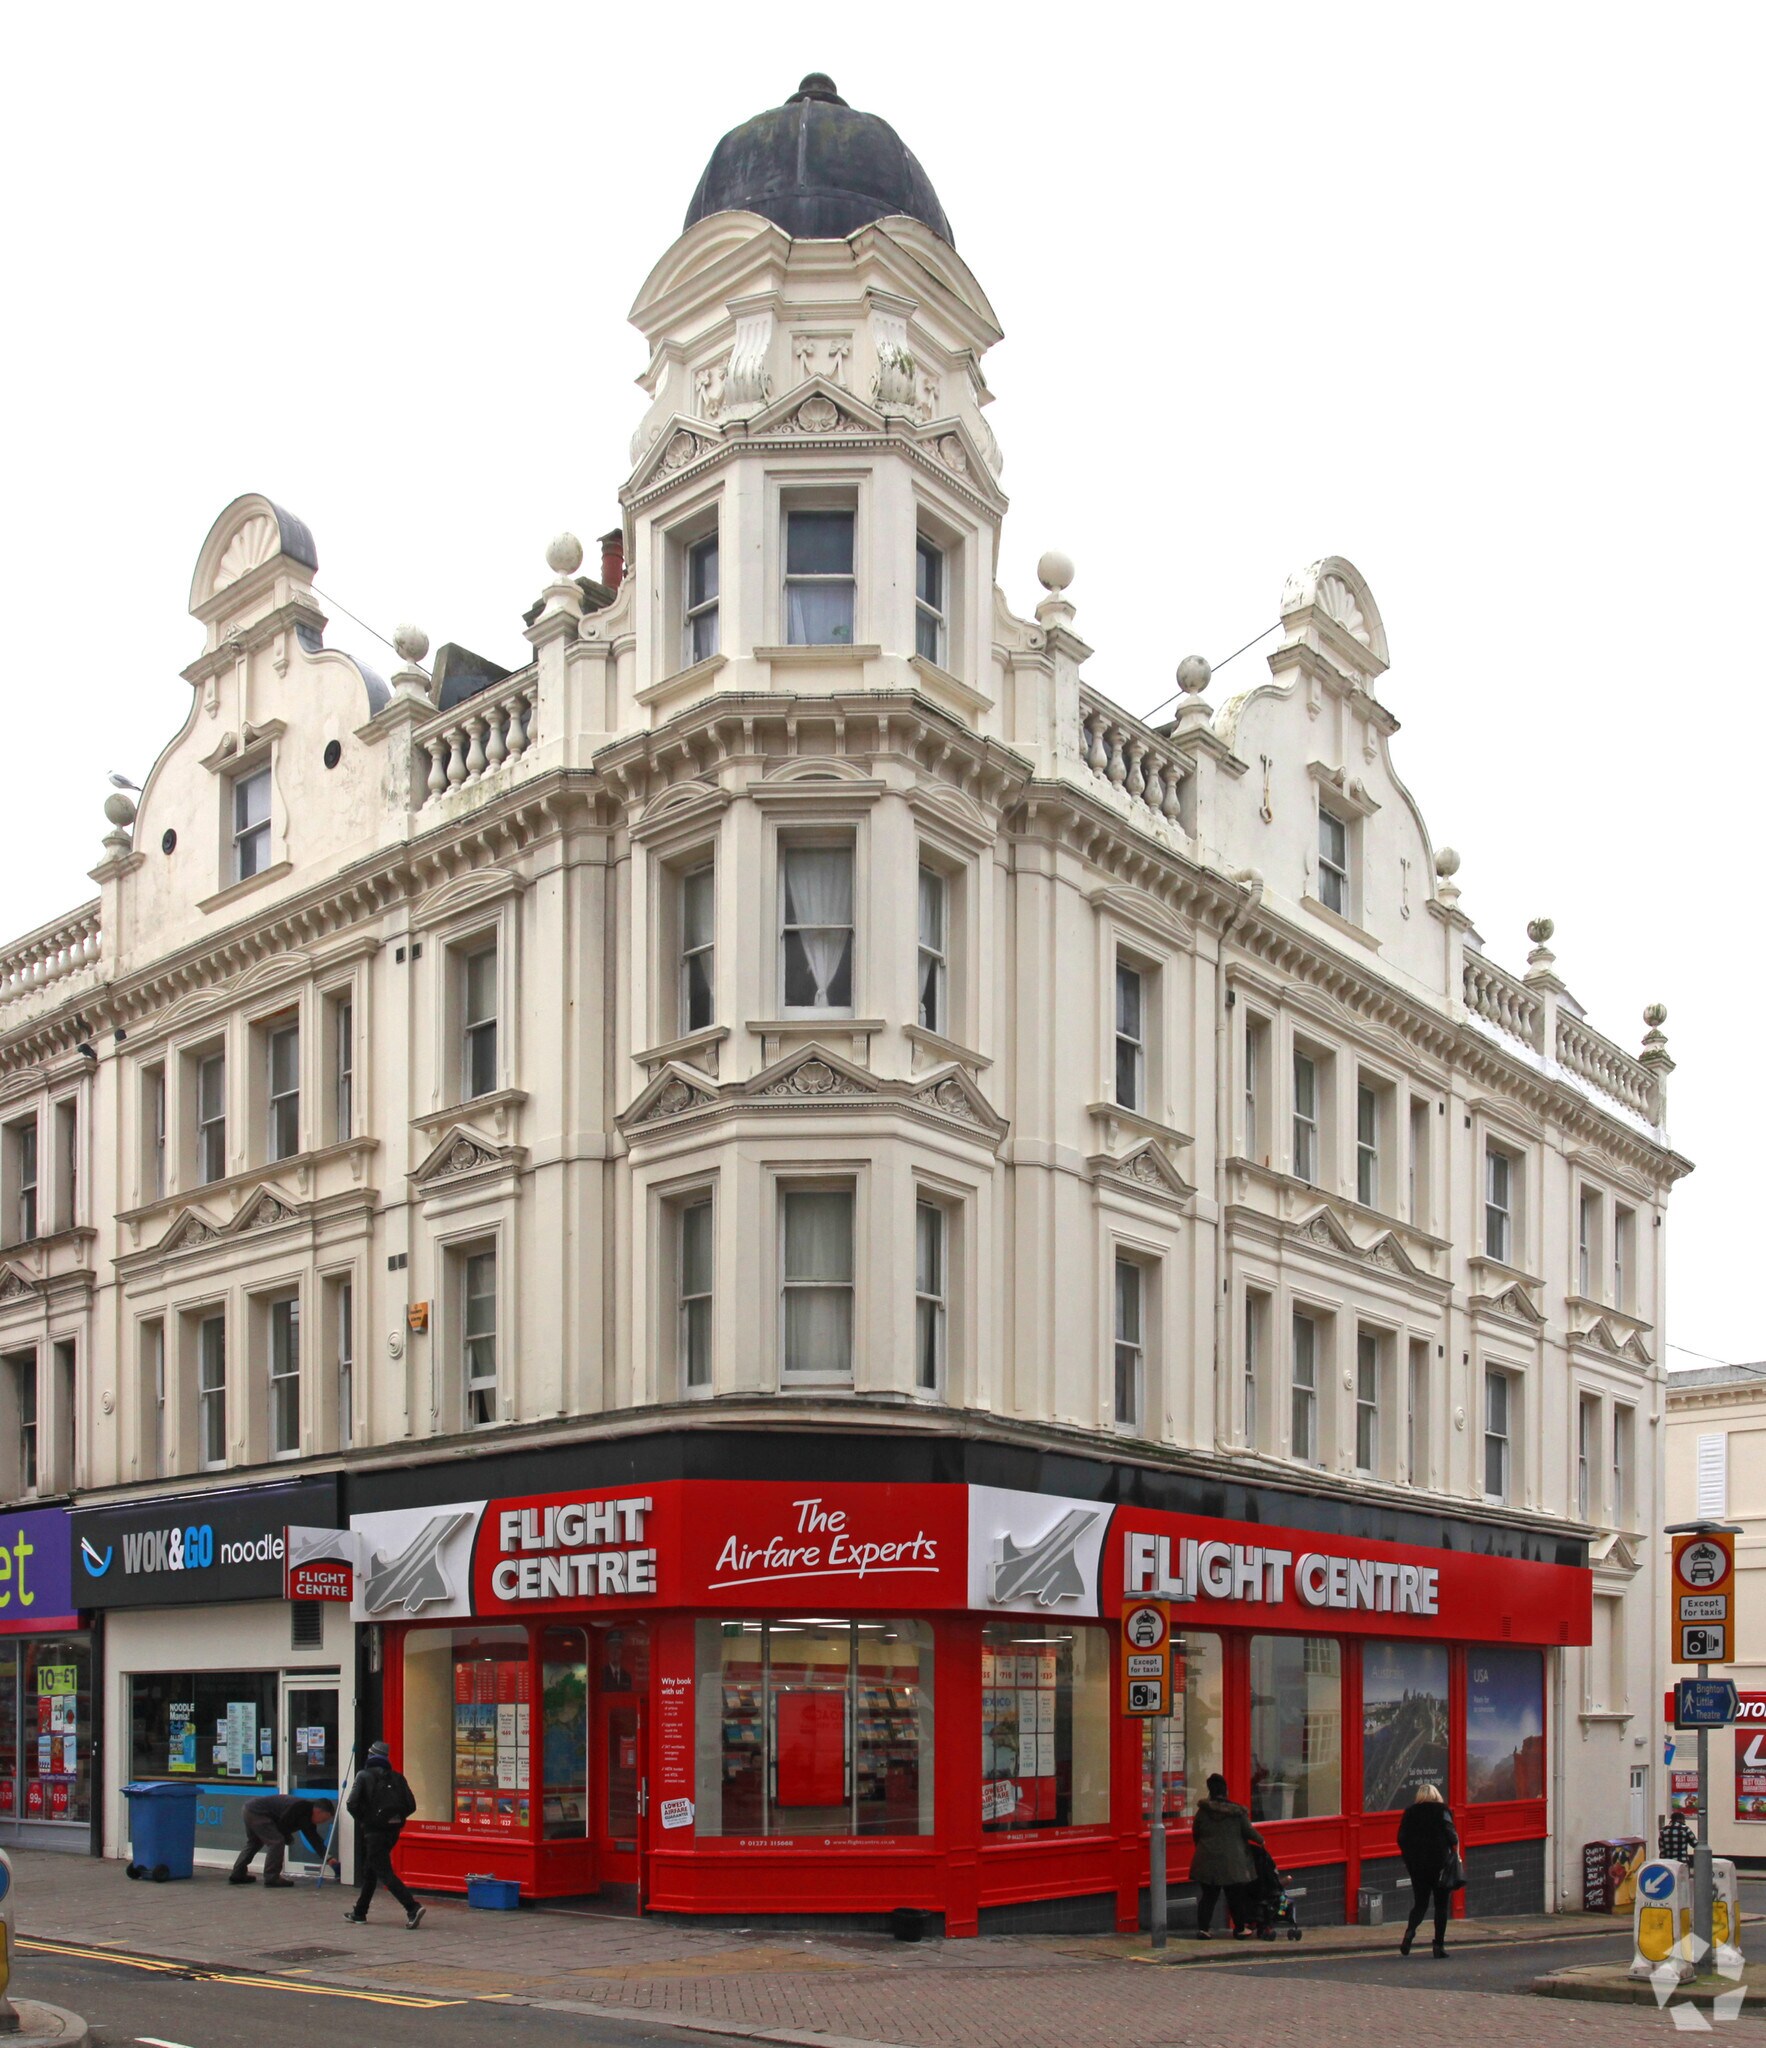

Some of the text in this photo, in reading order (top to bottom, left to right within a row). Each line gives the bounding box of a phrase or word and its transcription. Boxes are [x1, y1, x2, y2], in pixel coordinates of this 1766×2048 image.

[793, 1498, 846, 1533] The
[500, 1497, 652, 1552] FLIGHT
[122, 1524, 214, 1574] WOK&GO
[715, 1531, 938, 1579] Airfare Experts
[298, 1572, 346, 1584] FLIGHT
[492, 1548, 657, 1600] CENTRE
[1124, 1531, 1439, 1615] FLIGHT CENTRE
[296, 1584, 348, 1596] CENTRE
[1687, 1599, 1719, 1608] Except
[1700, 1608, 1722, 1616] taxis
[39, 1669, 54, 1690] 10
[661, 1677, 691, 1686] Why book
[1474, 1669, 1489, 1682] USA
[661, 1687, 685, 1695] with us?
[1696, 1683, 1724, 1695] Brighton
[169, 1703, 195, 1712] NOODLE
[1696, 1697, 1714, 1706] Little
[169, 1711, 190, 1720] Mania!
[1696, 1710, 1721, 1719] Theatre
[29, 1792, 42, 1804] 99p
[664, 1801, 686, 1810] LOWEST
[664, 1806, 688, 1815] AIRFARE
